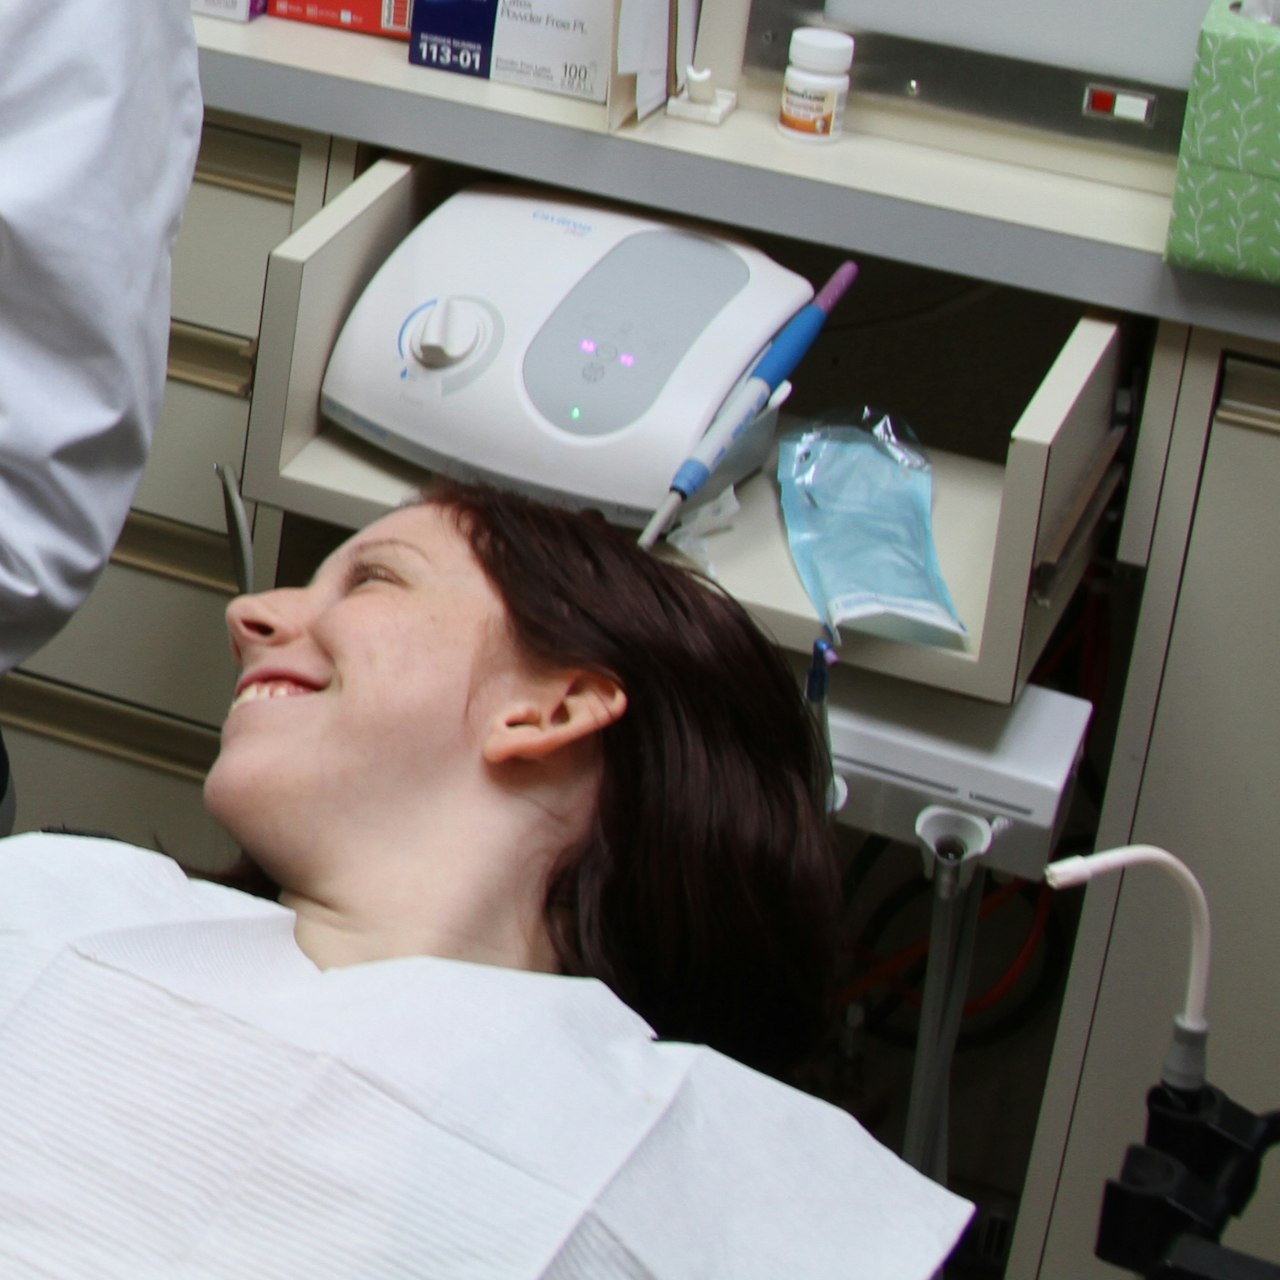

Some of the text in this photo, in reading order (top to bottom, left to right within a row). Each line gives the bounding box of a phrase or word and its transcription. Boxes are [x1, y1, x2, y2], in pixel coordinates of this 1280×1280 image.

[500, 7, 542, 25] Powder
[545, 14, 571, 30] Free
[419, 42, 482, 71] 113-01
[563, 62, 588, 81] 100
